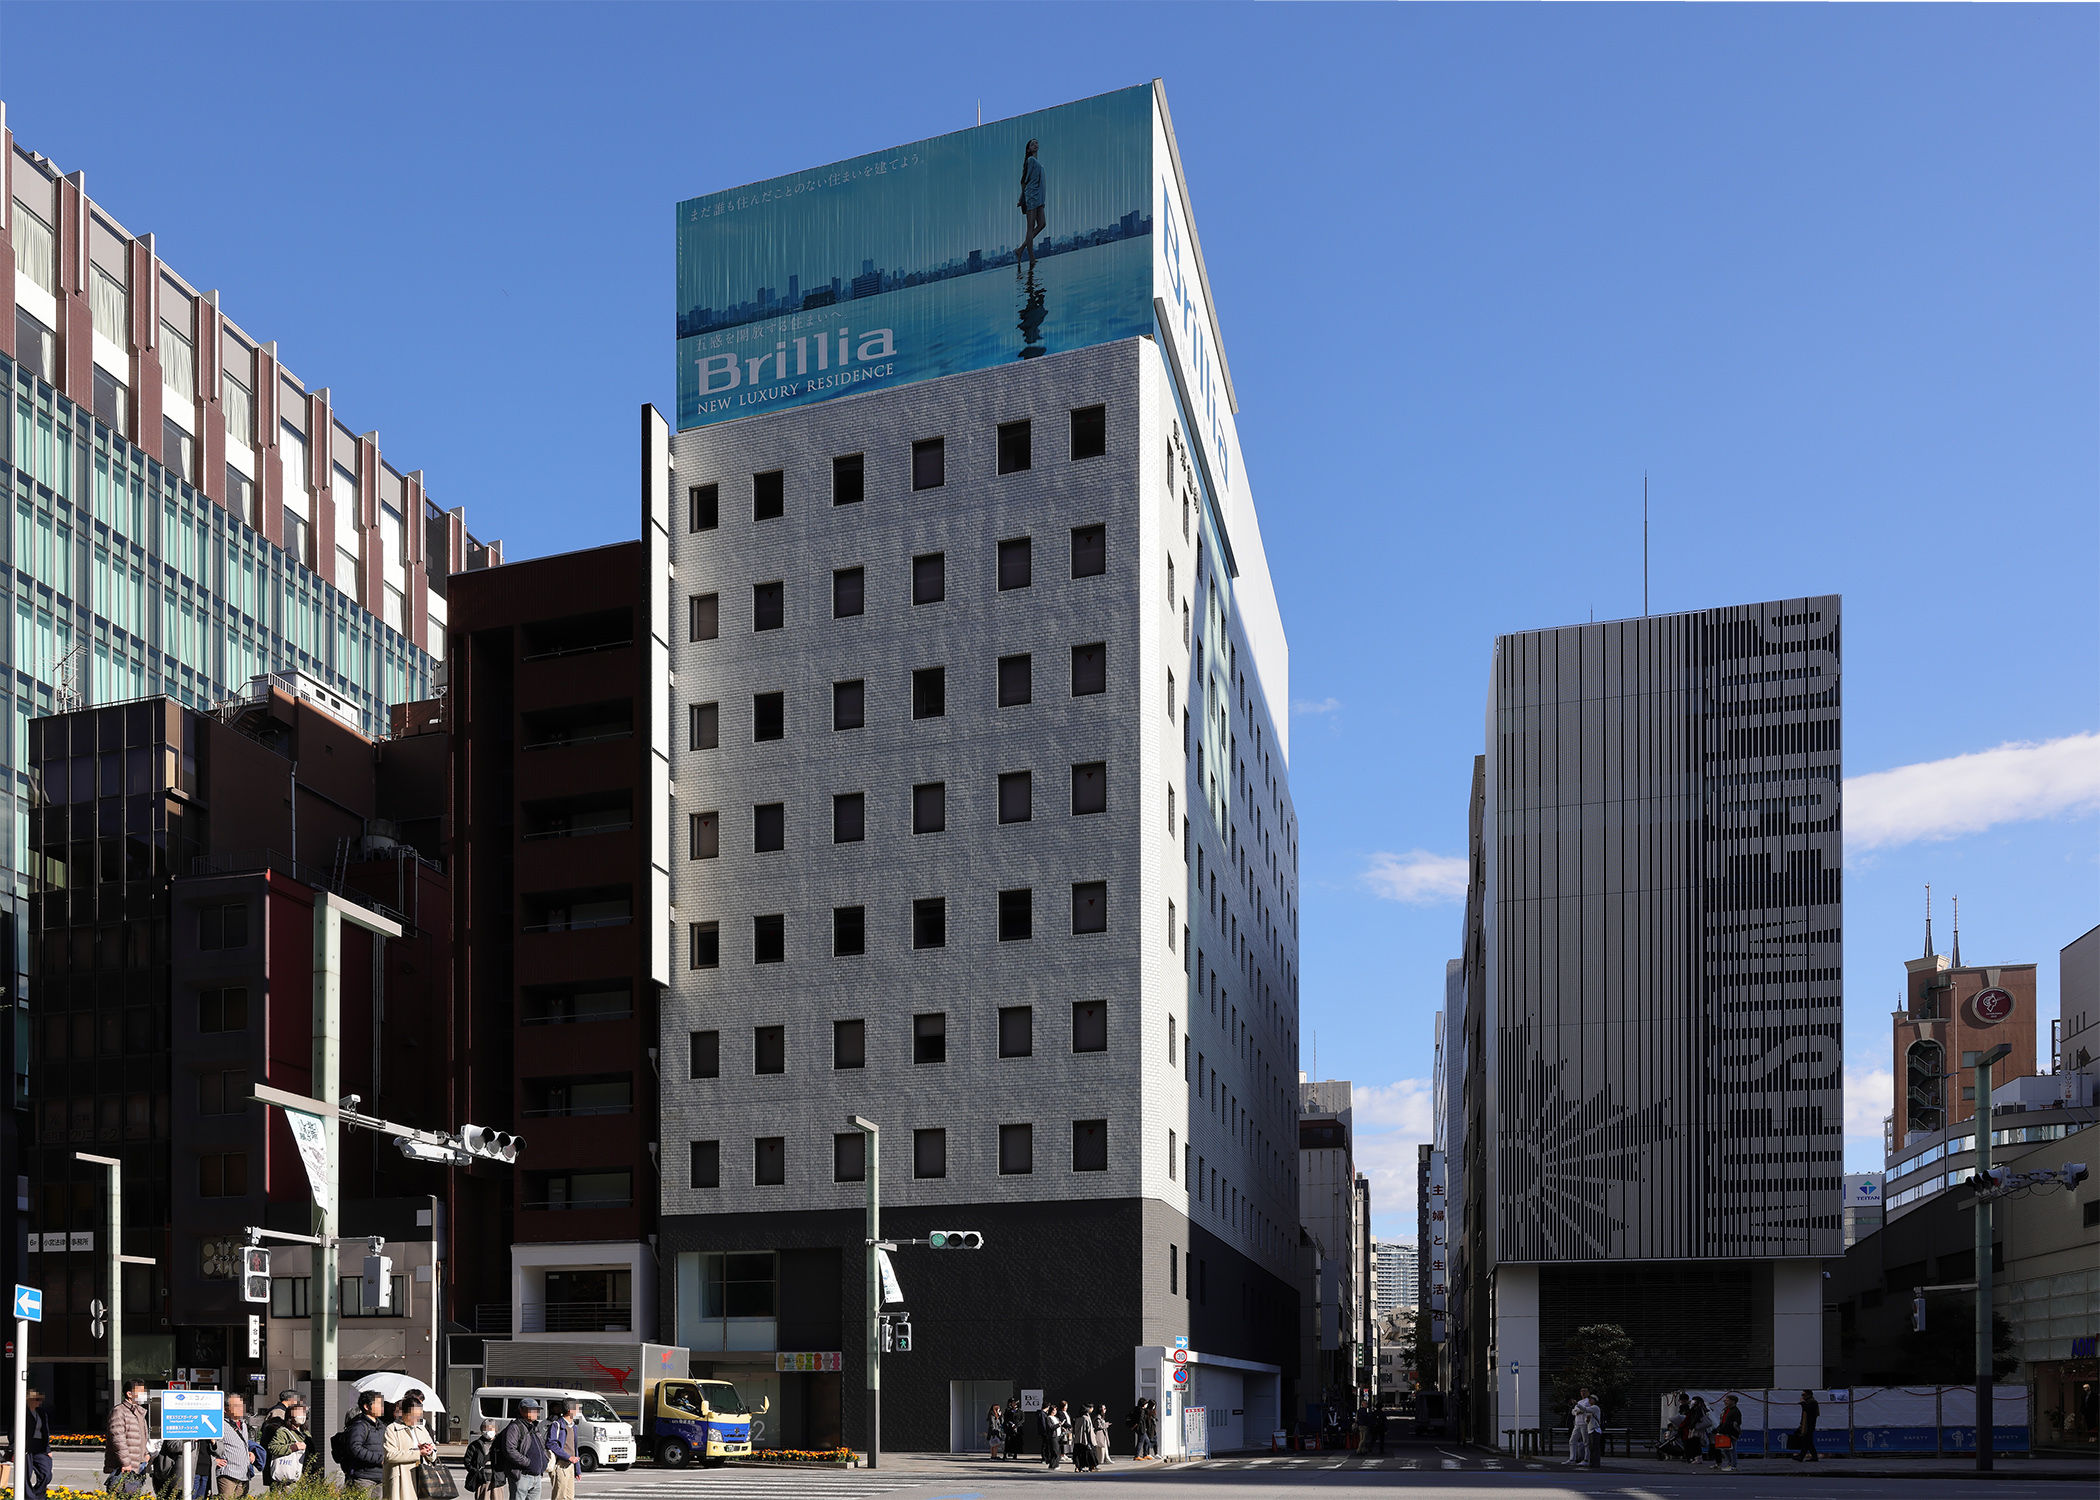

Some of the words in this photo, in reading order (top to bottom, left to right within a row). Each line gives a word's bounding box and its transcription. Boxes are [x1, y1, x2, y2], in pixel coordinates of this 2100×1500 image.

[694, 327, 898, 396] Brillia
[697, 397, 732, 415] NEW
[739, 382, 800, 406] LUXURY
[807, 362, 894, 392] RESIDENCE
[1432, 1184, 1445, 1322] 主婦と生活社
[1176, 1352, 1185, 1360] 30
[2071, 1338, 2096, 1357] AOKI
